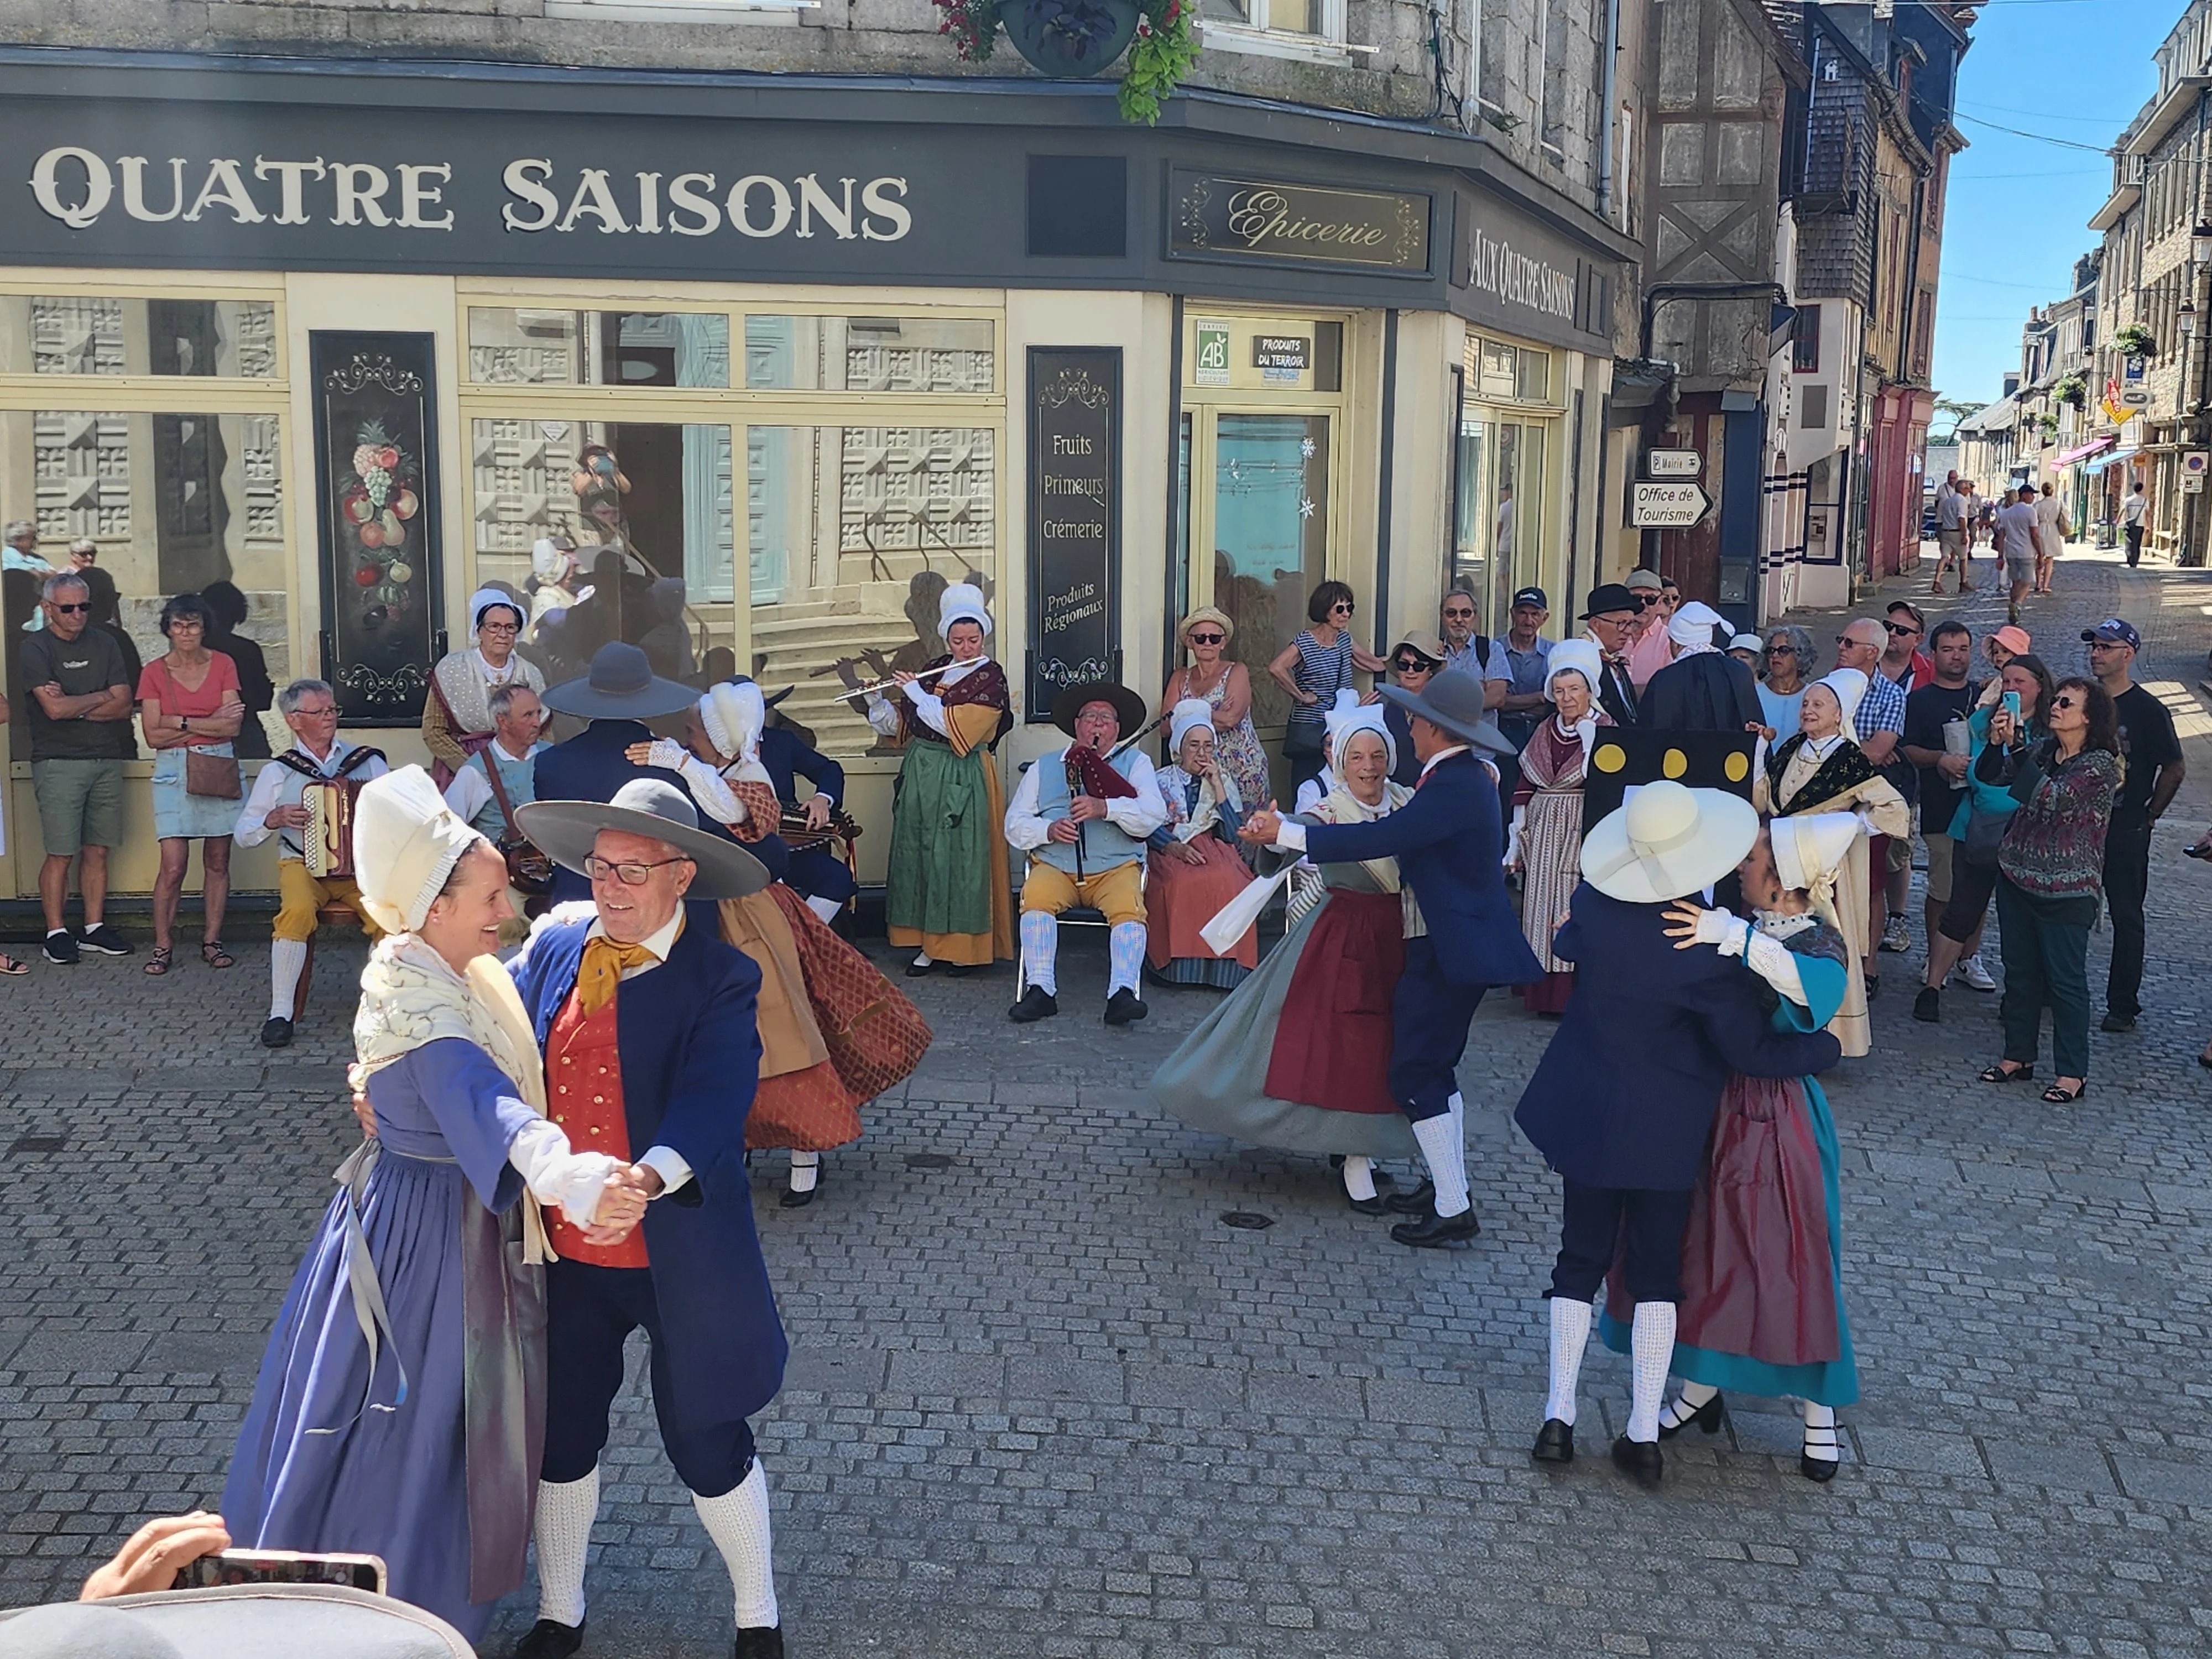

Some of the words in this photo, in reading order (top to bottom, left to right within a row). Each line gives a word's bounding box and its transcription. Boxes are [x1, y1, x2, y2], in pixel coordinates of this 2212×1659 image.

[27, 147, 455, 231] QUATRE
[500, 158, 912, 241] SAISONS
[1470, 228, 1498, 293] AUX
[1499, 241, 1540, 310] QUATRE
[1540, 262, 1575, 320] SAISONS
[1200, 342, 1224, 367] AB
[1262, 338, 1301, 352] PRODUITS
[1258, 354, 1270, 366] DU
[1271, 354, 1304, 368] TERROIR
[1053, 434, 1093, 455] Fruits
[1662, 458, 1683, 469] Mairie
[1044, 474, 1103, 495] Primeurs
[1639, 488, 1674, 501] Office
[1678, 488, 1694, 501] de
[1638, 507, 1693, 521] Tourisme
[1044, 518, 1103, 539] Crémerie
[1047, 582, 1094, 611] Produits
[1044, 598, 1103, 633] Régionaux
